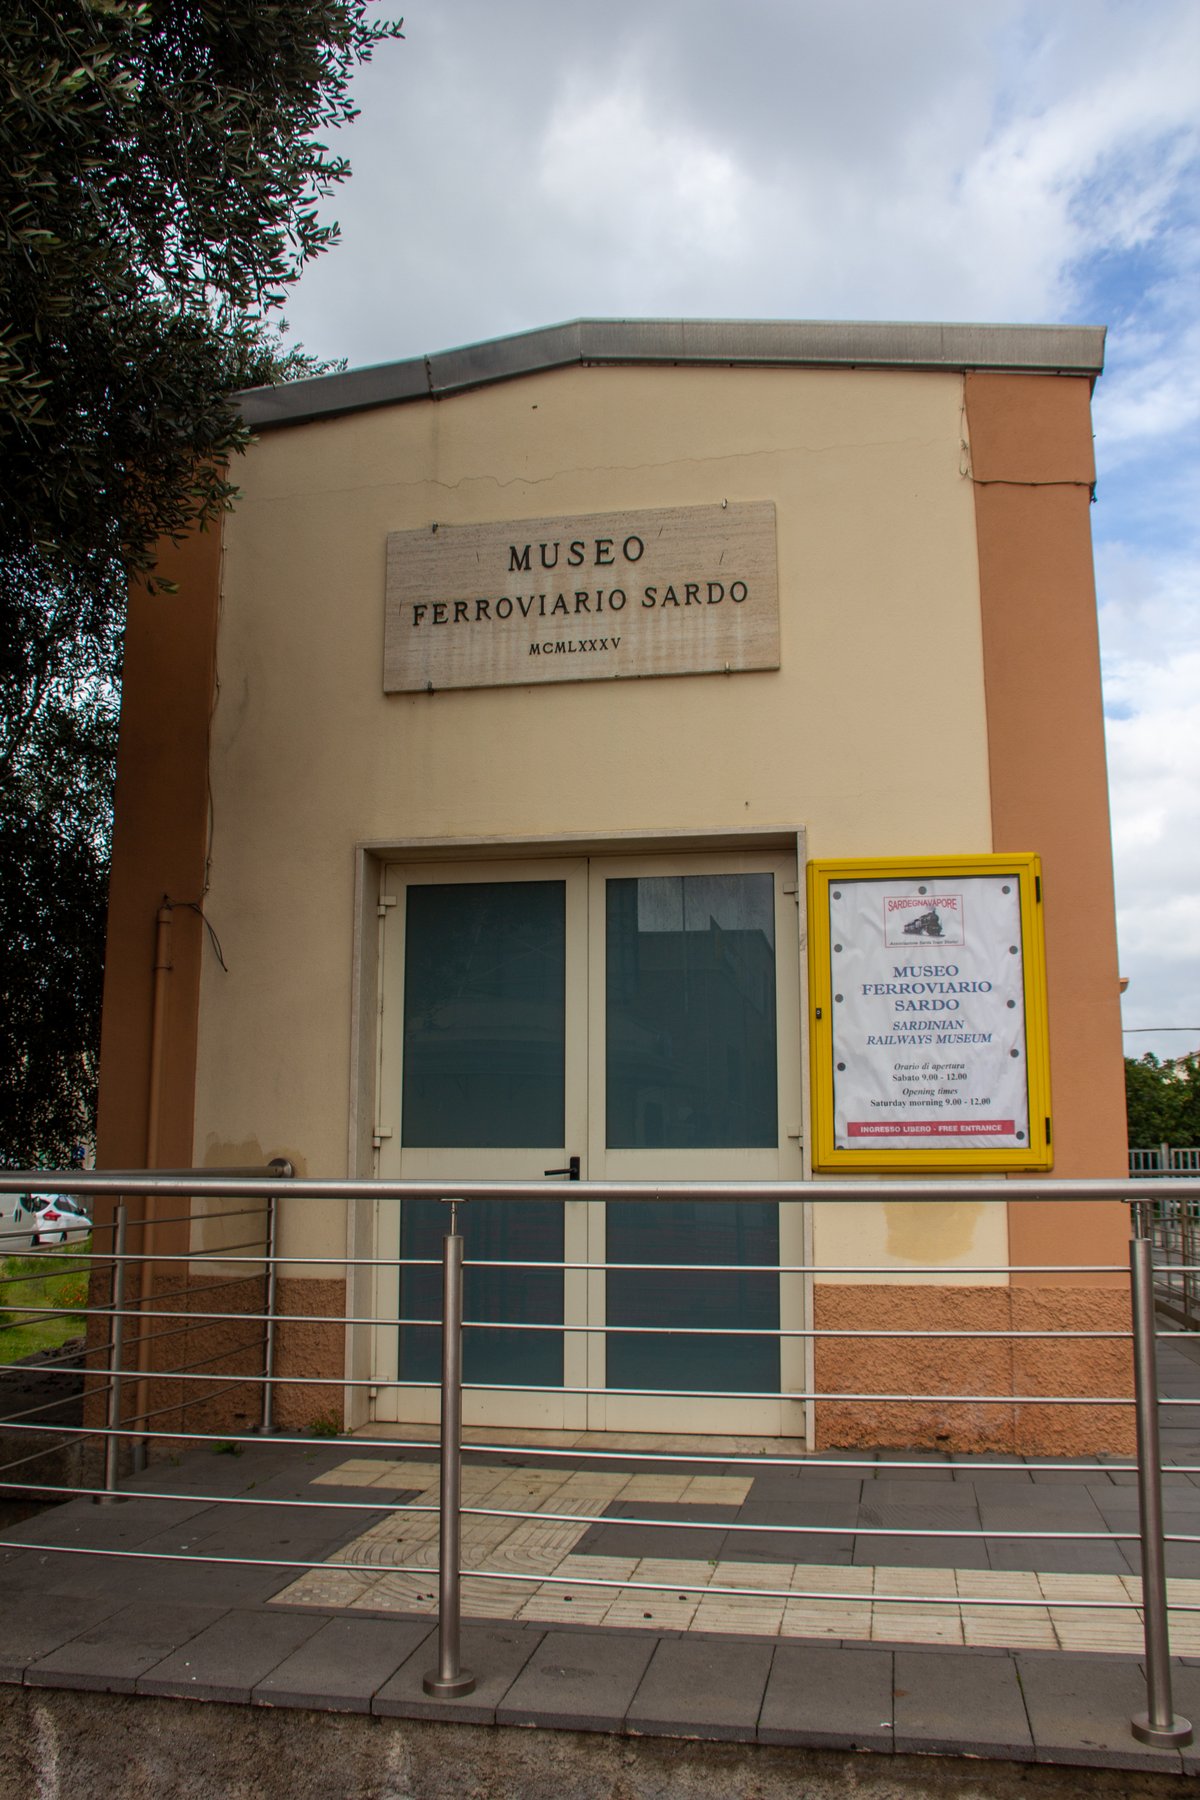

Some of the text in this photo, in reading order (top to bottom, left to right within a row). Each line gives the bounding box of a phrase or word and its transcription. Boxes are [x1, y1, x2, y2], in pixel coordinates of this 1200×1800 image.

[508, 535, 645, 571] MUSEO
[412, 581, 748, 626] FERROVIARIO SARDO
[529, 637, 621, 655] MCMLXXXV
[888, 899, 957, 912] SARDEGNAVAPORE
[893, 965, 959, 978] MUSEO
[862, 981, 992, 995] FERROVIARIO
[895, 999, 959, 1011] SARDO
[893, 1020, 964, 1031] SARDINIAN
[866, 1033, 992, 1045] RAILWAYS MUSEUM
[894, 1062, 965, 1072] Orario di apertura
[902, 1087, 958, 1096] Opening times
[870, 1099, 906, 1108] Saturday
[909, 1099, 943, 1107] morning
[945, 1098, 961, 1106] 9.00
[970, 1097, 991, 1105] 12.00
[960, 1124, 1002, 1132] ENTRANCE
